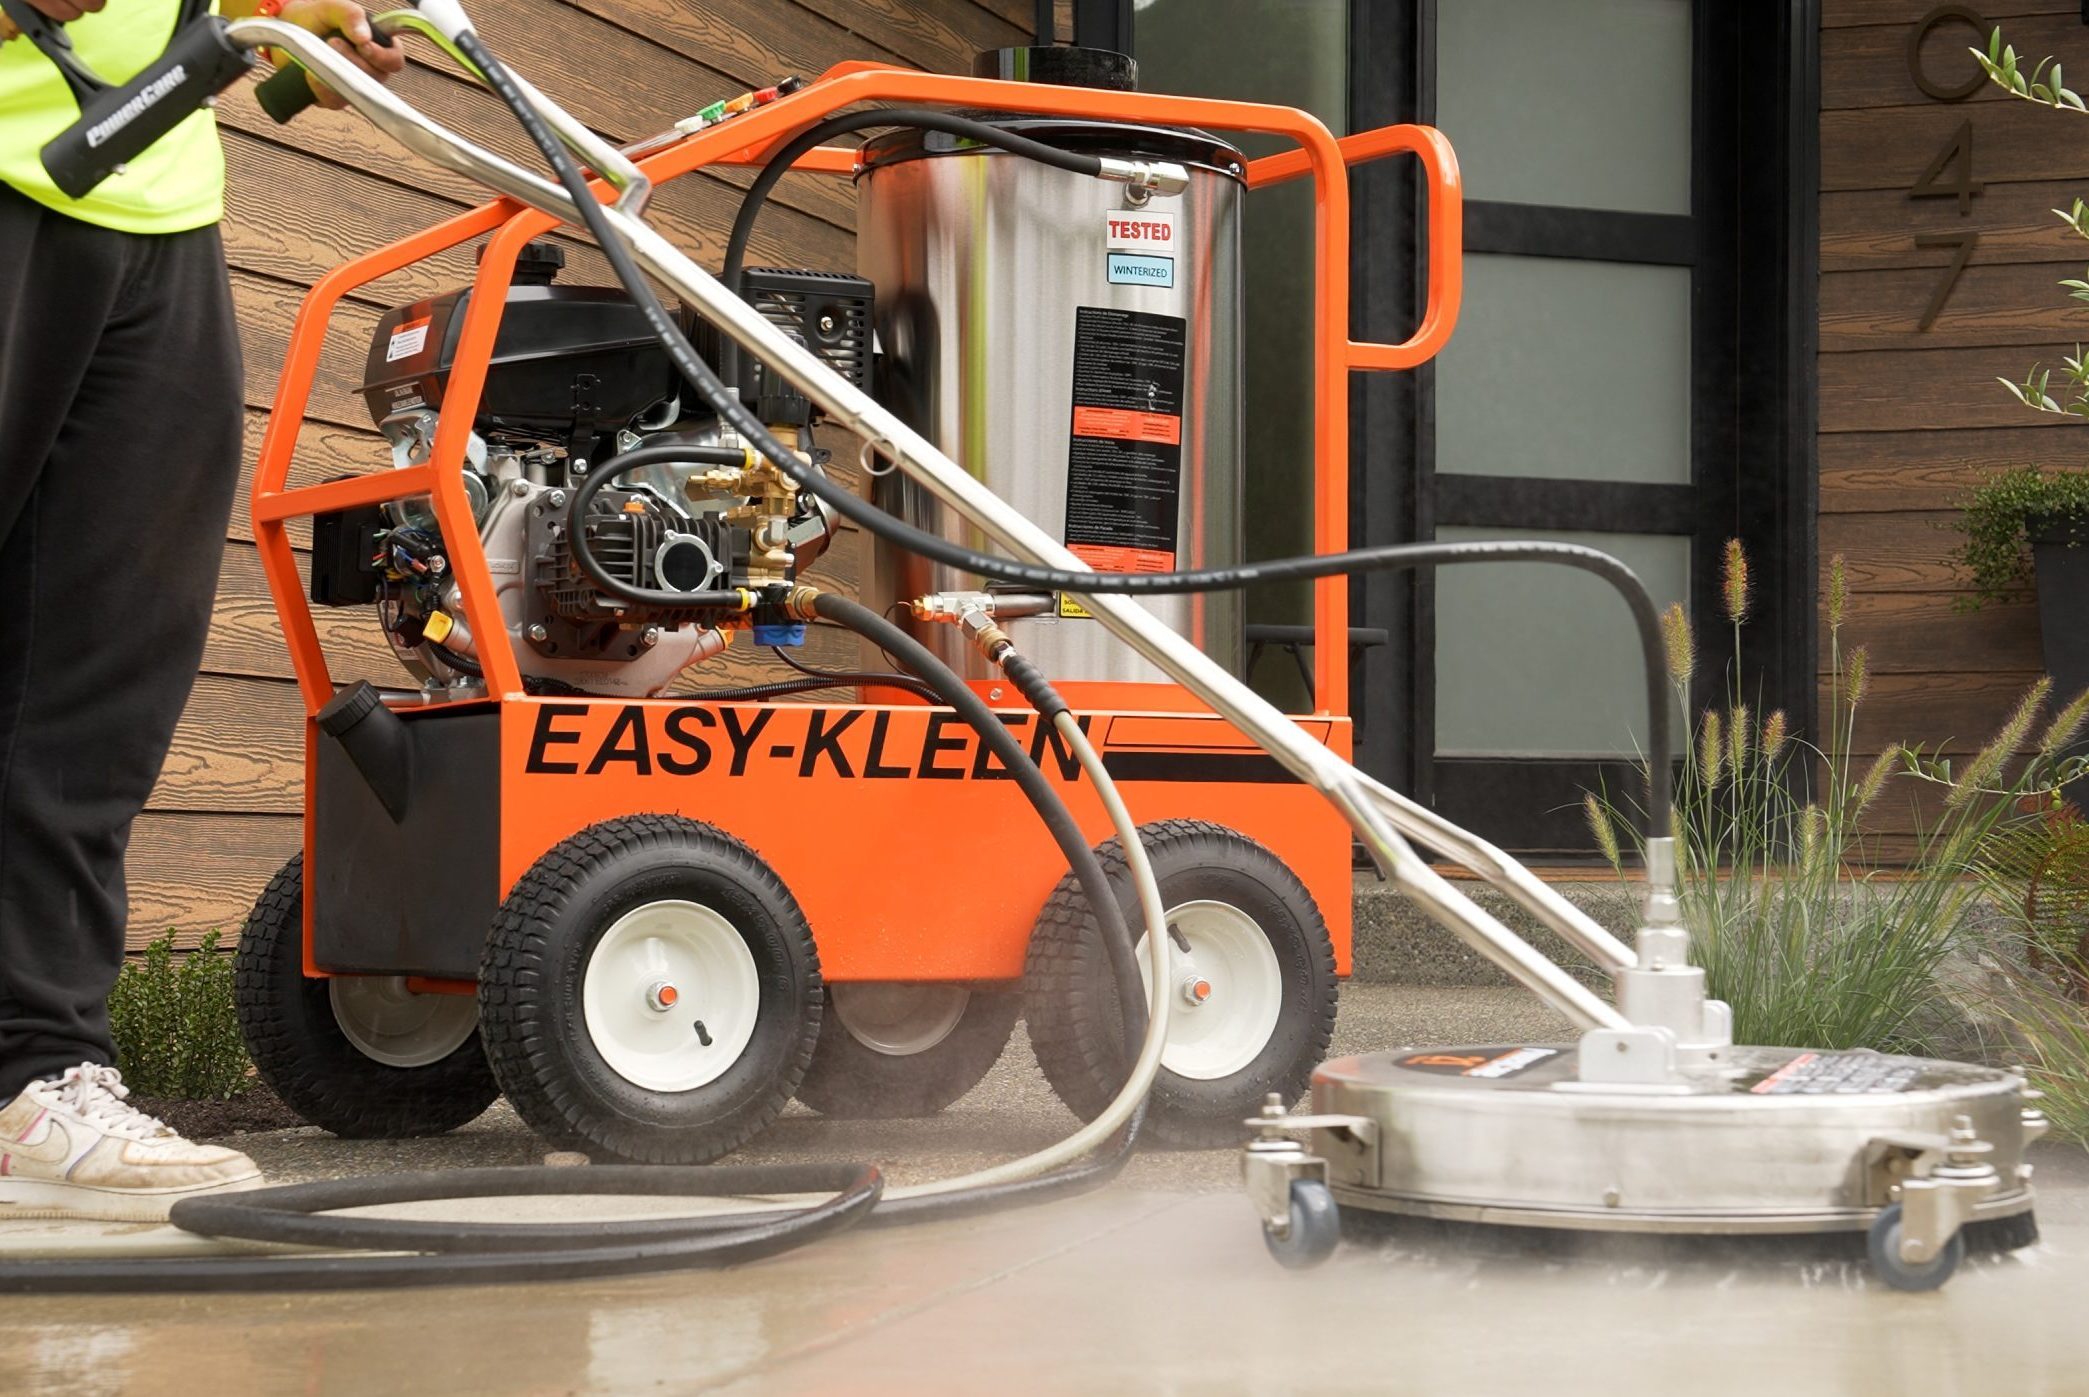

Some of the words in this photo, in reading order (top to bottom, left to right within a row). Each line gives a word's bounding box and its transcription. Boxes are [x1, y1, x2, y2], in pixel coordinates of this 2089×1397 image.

[1108, 220, 1171, 241] TESTED
[1114, 265, 1168, 278] WINTERIZED
[525, 703, 1092, 781] EASY-KLEEN
